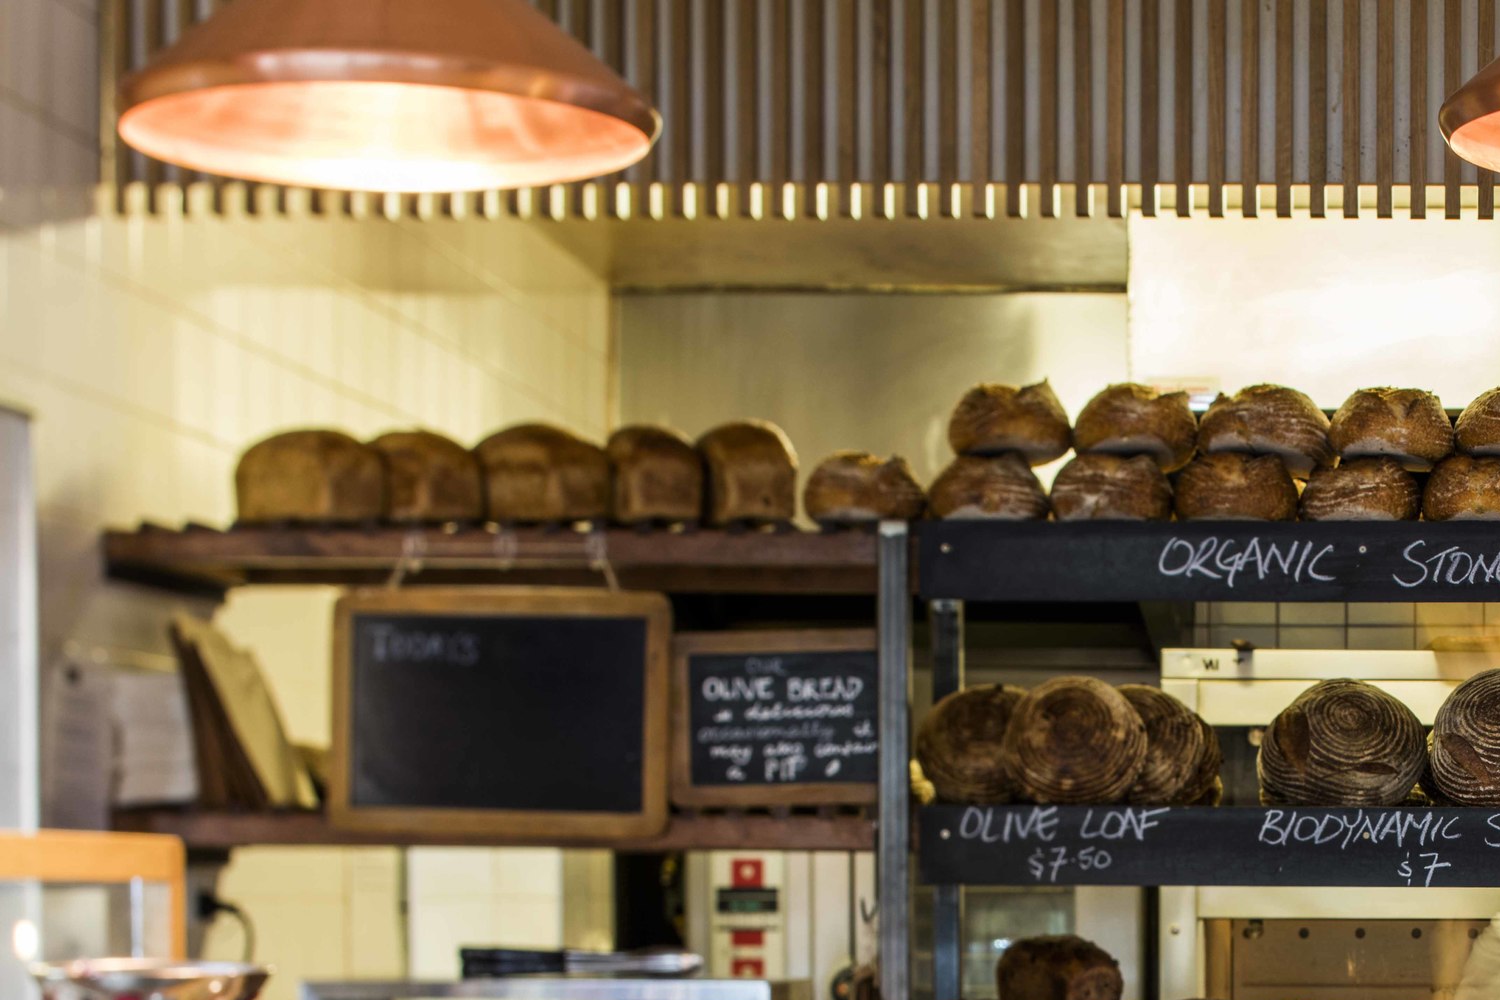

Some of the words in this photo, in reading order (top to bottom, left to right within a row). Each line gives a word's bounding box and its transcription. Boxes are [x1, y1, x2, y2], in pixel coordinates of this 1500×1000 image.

[1158, 536, 1336, 588] ORGANIC
[702, 676, 774, 701] OLIVE
[787, 676, 864, 701] BREAD
[709, 743, 752, 767] may
[763, 742, 804, 758] also
[959, 806, 1060, 843] OLIVE
[1079, 807, 1171, 841] LOAF
[1258, 808, 1462, 850] BIODYNAMIC
[1027, 846, 1112, 882] $7.50
[1397, 851, 1452, 888] $7
